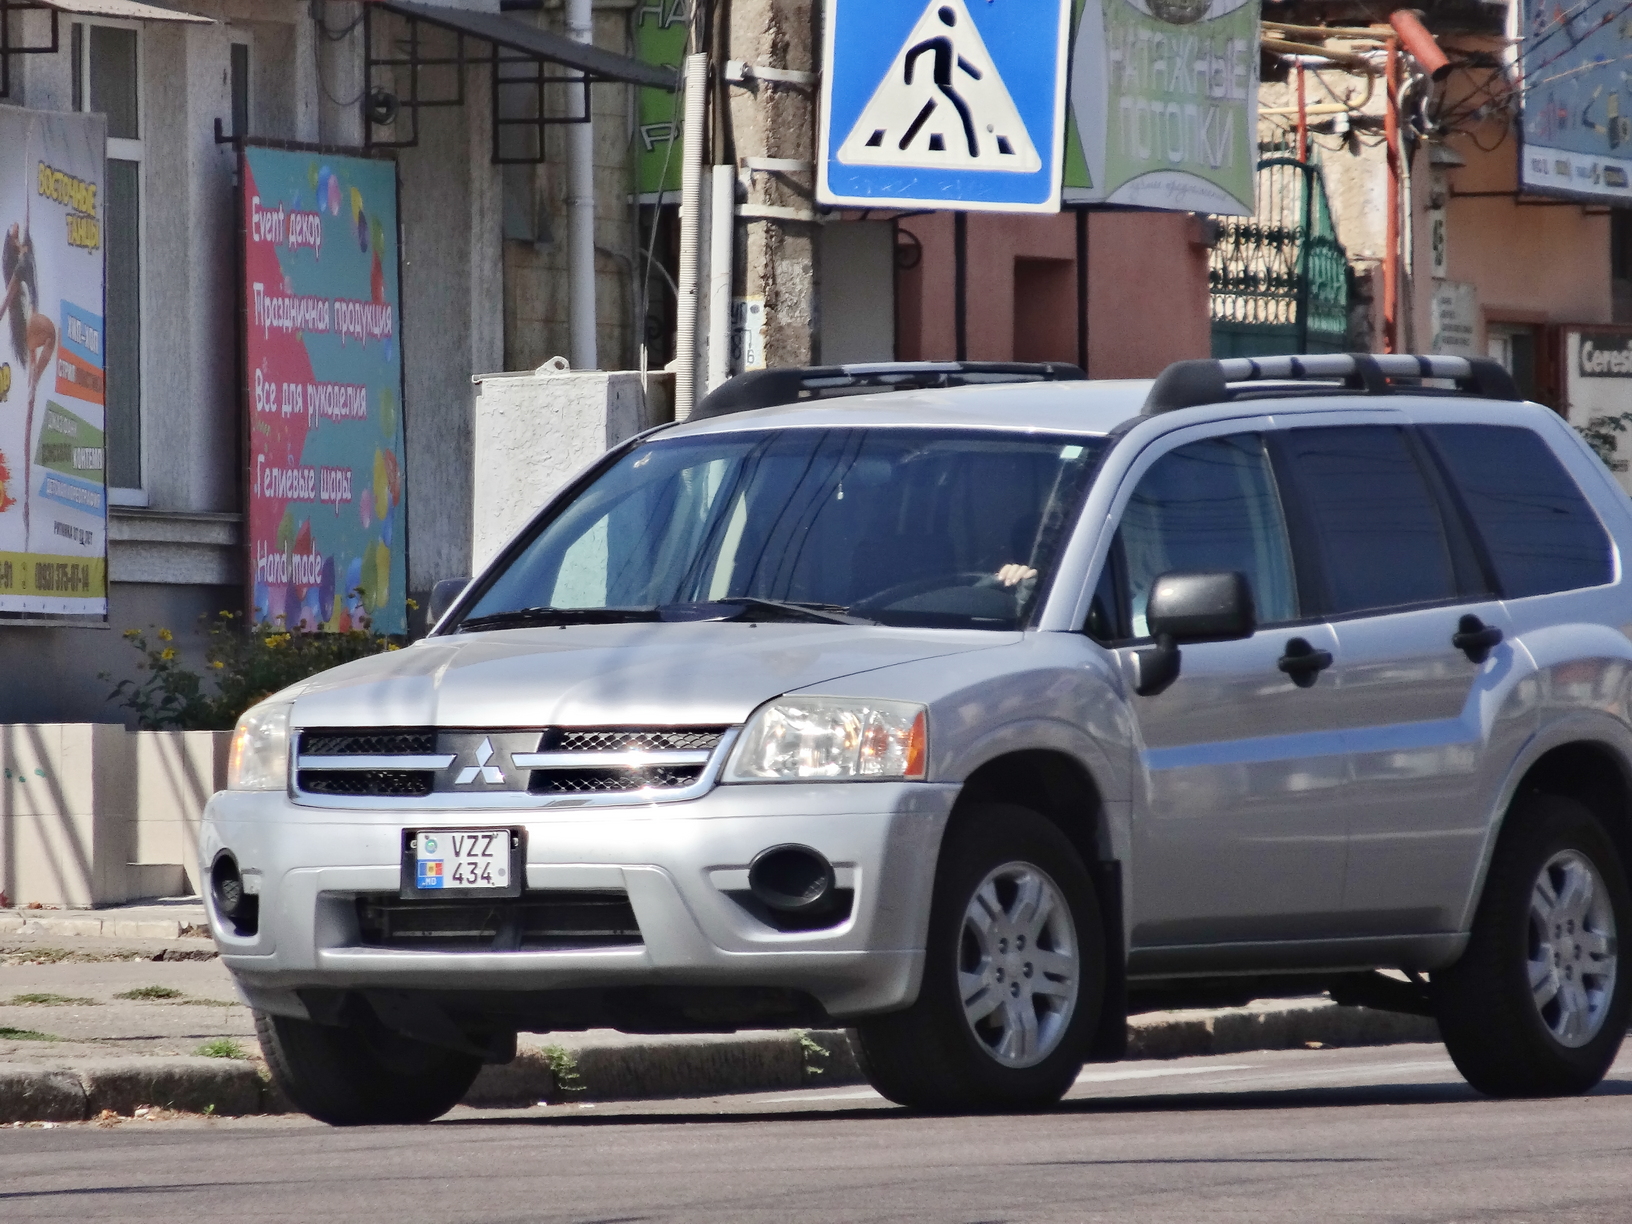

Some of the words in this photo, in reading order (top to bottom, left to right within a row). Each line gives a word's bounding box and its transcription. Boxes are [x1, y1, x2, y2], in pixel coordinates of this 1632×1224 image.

[1109, 28, 1248, 99] НАТЯЖНЫЕ
[1119, 96, 1235, 169] ПОТОЛКИ
[38, 160, 97, 219] ВОСТОЧНЫЕ
[66, 212, 100, 255] ТАНЦЫ
[252, 196, 284, 242] Event
[288, 213, 321, 259] декор
[253, 282, 330, 340] Праздничная
[334, 301, 392, 346] продукция
[255, 368, 277, 412] Все
[282, 382, 303, 418] для
[307, 383, 367, 428] рукоделия
[256, 454, 315, 499] Гелиевые
[320, 469, 352, 515] шары
[257, 540, 287, 584] Hand
[292, 540, 322, 585] made
[452, 835, 494, 857] VZZ
[452, 862, 493, 884] 434
